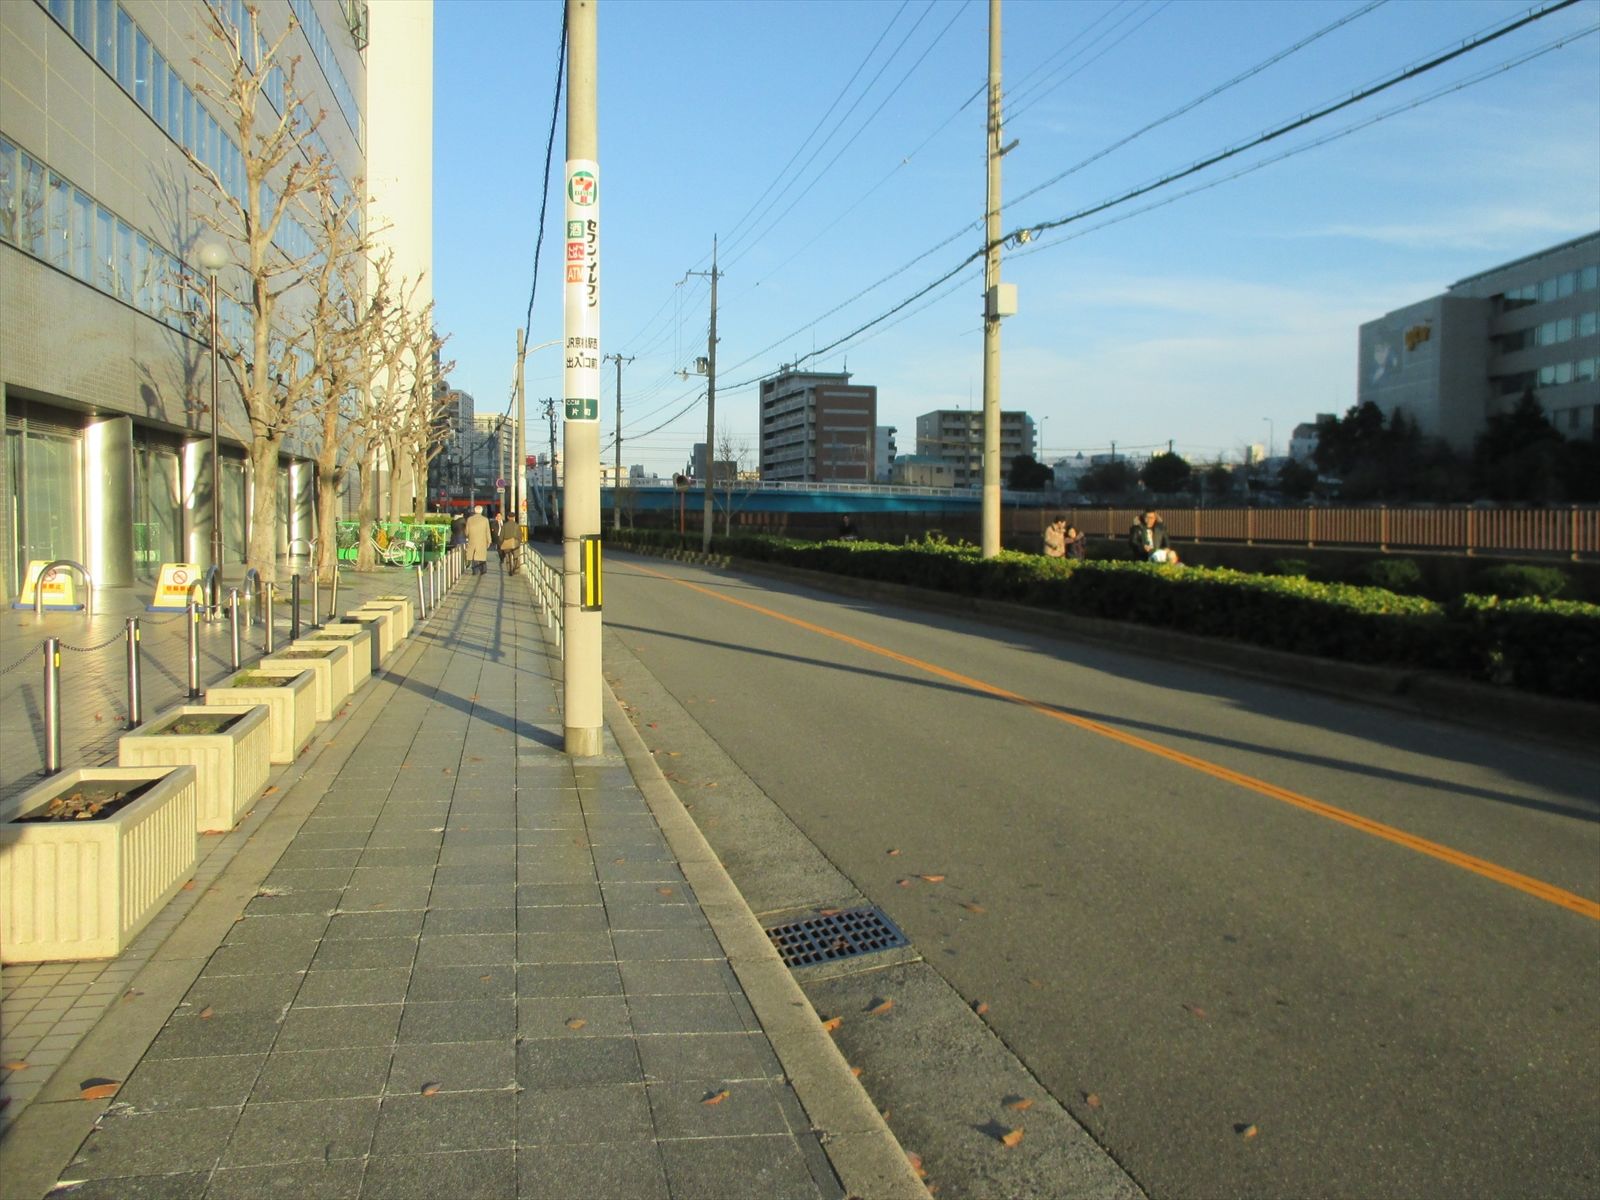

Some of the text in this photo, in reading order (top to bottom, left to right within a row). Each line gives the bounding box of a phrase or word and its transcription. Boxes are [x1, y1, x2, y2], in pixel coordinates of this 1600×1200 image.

[569, 222, 582, 237] 酒
[568, 267, 584, 280] ATM
[566, 357, 598, 369] 出入口前
